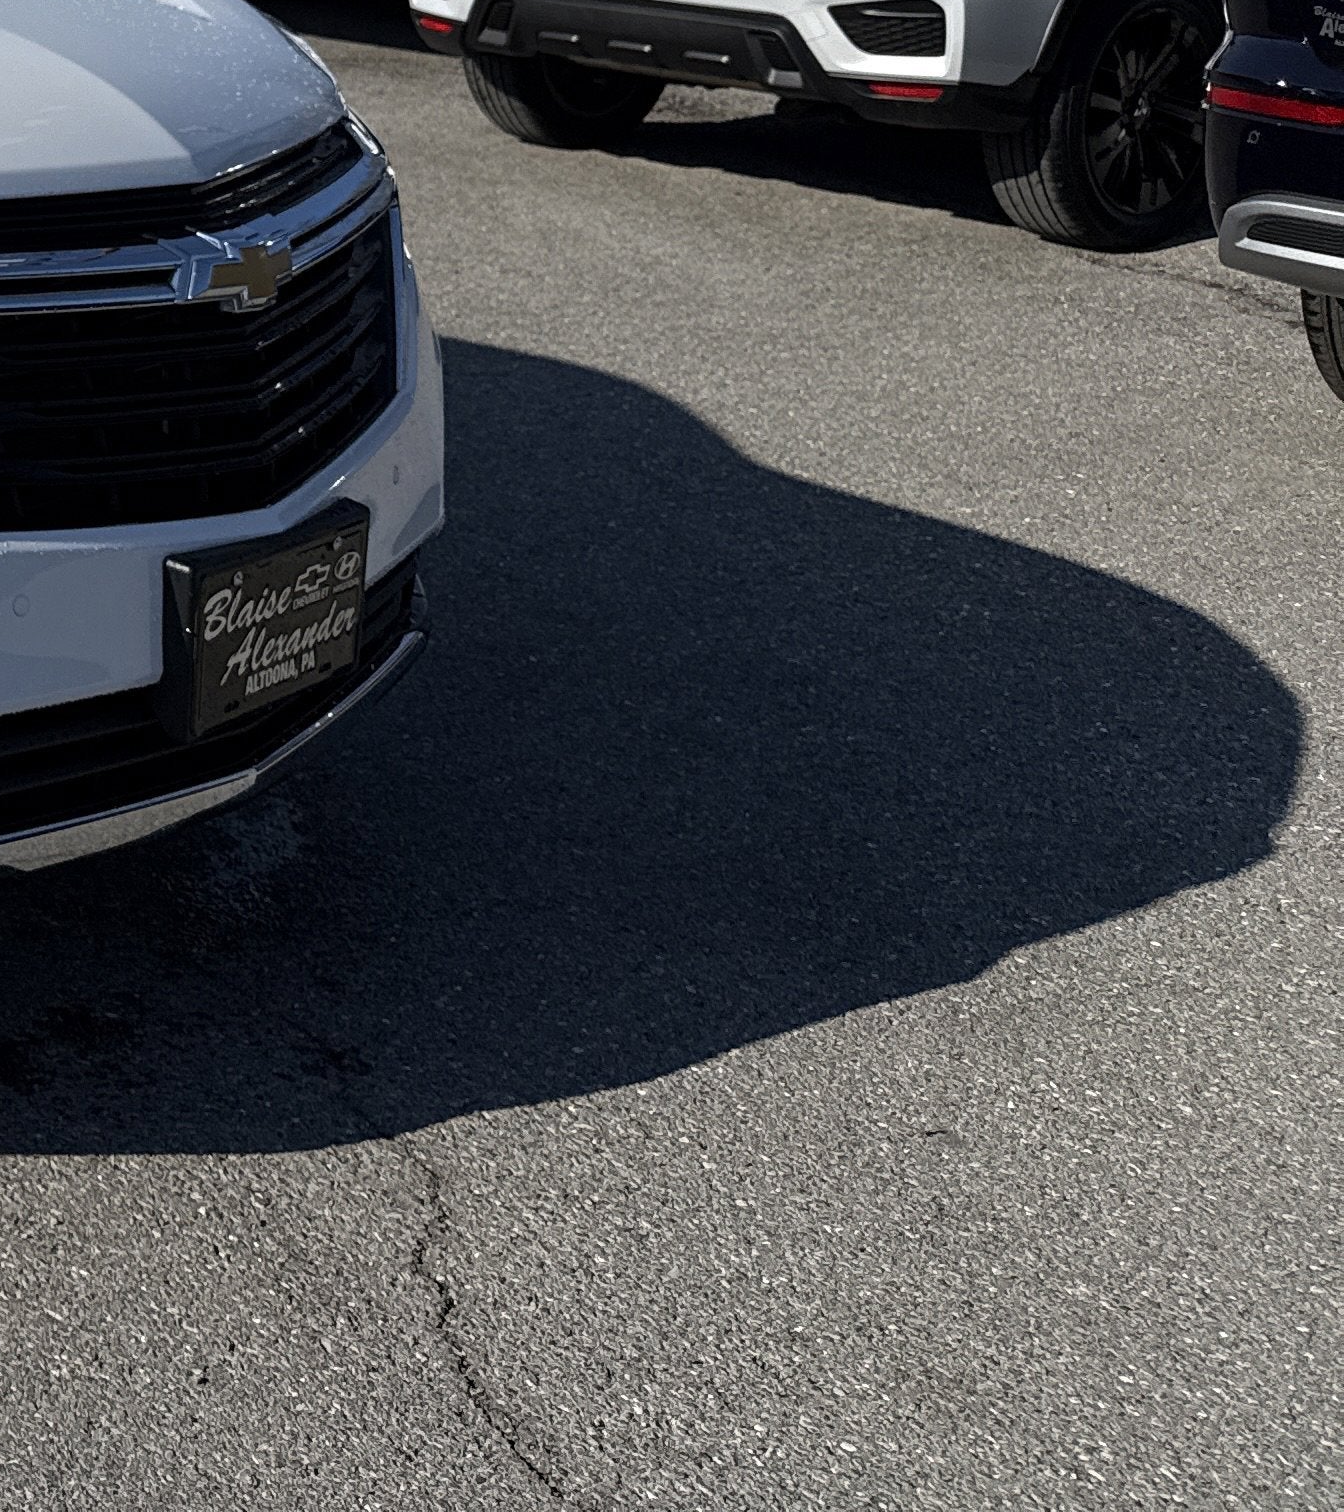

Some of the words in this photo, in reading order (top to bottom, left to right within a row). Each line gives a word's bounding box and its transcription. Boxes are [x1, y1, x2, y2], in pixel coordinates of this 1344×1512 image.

[203, 586, 292, 641] Blaise
[219, 599, 356, 686] Alexander
[300, 650, 316, 673] PA
